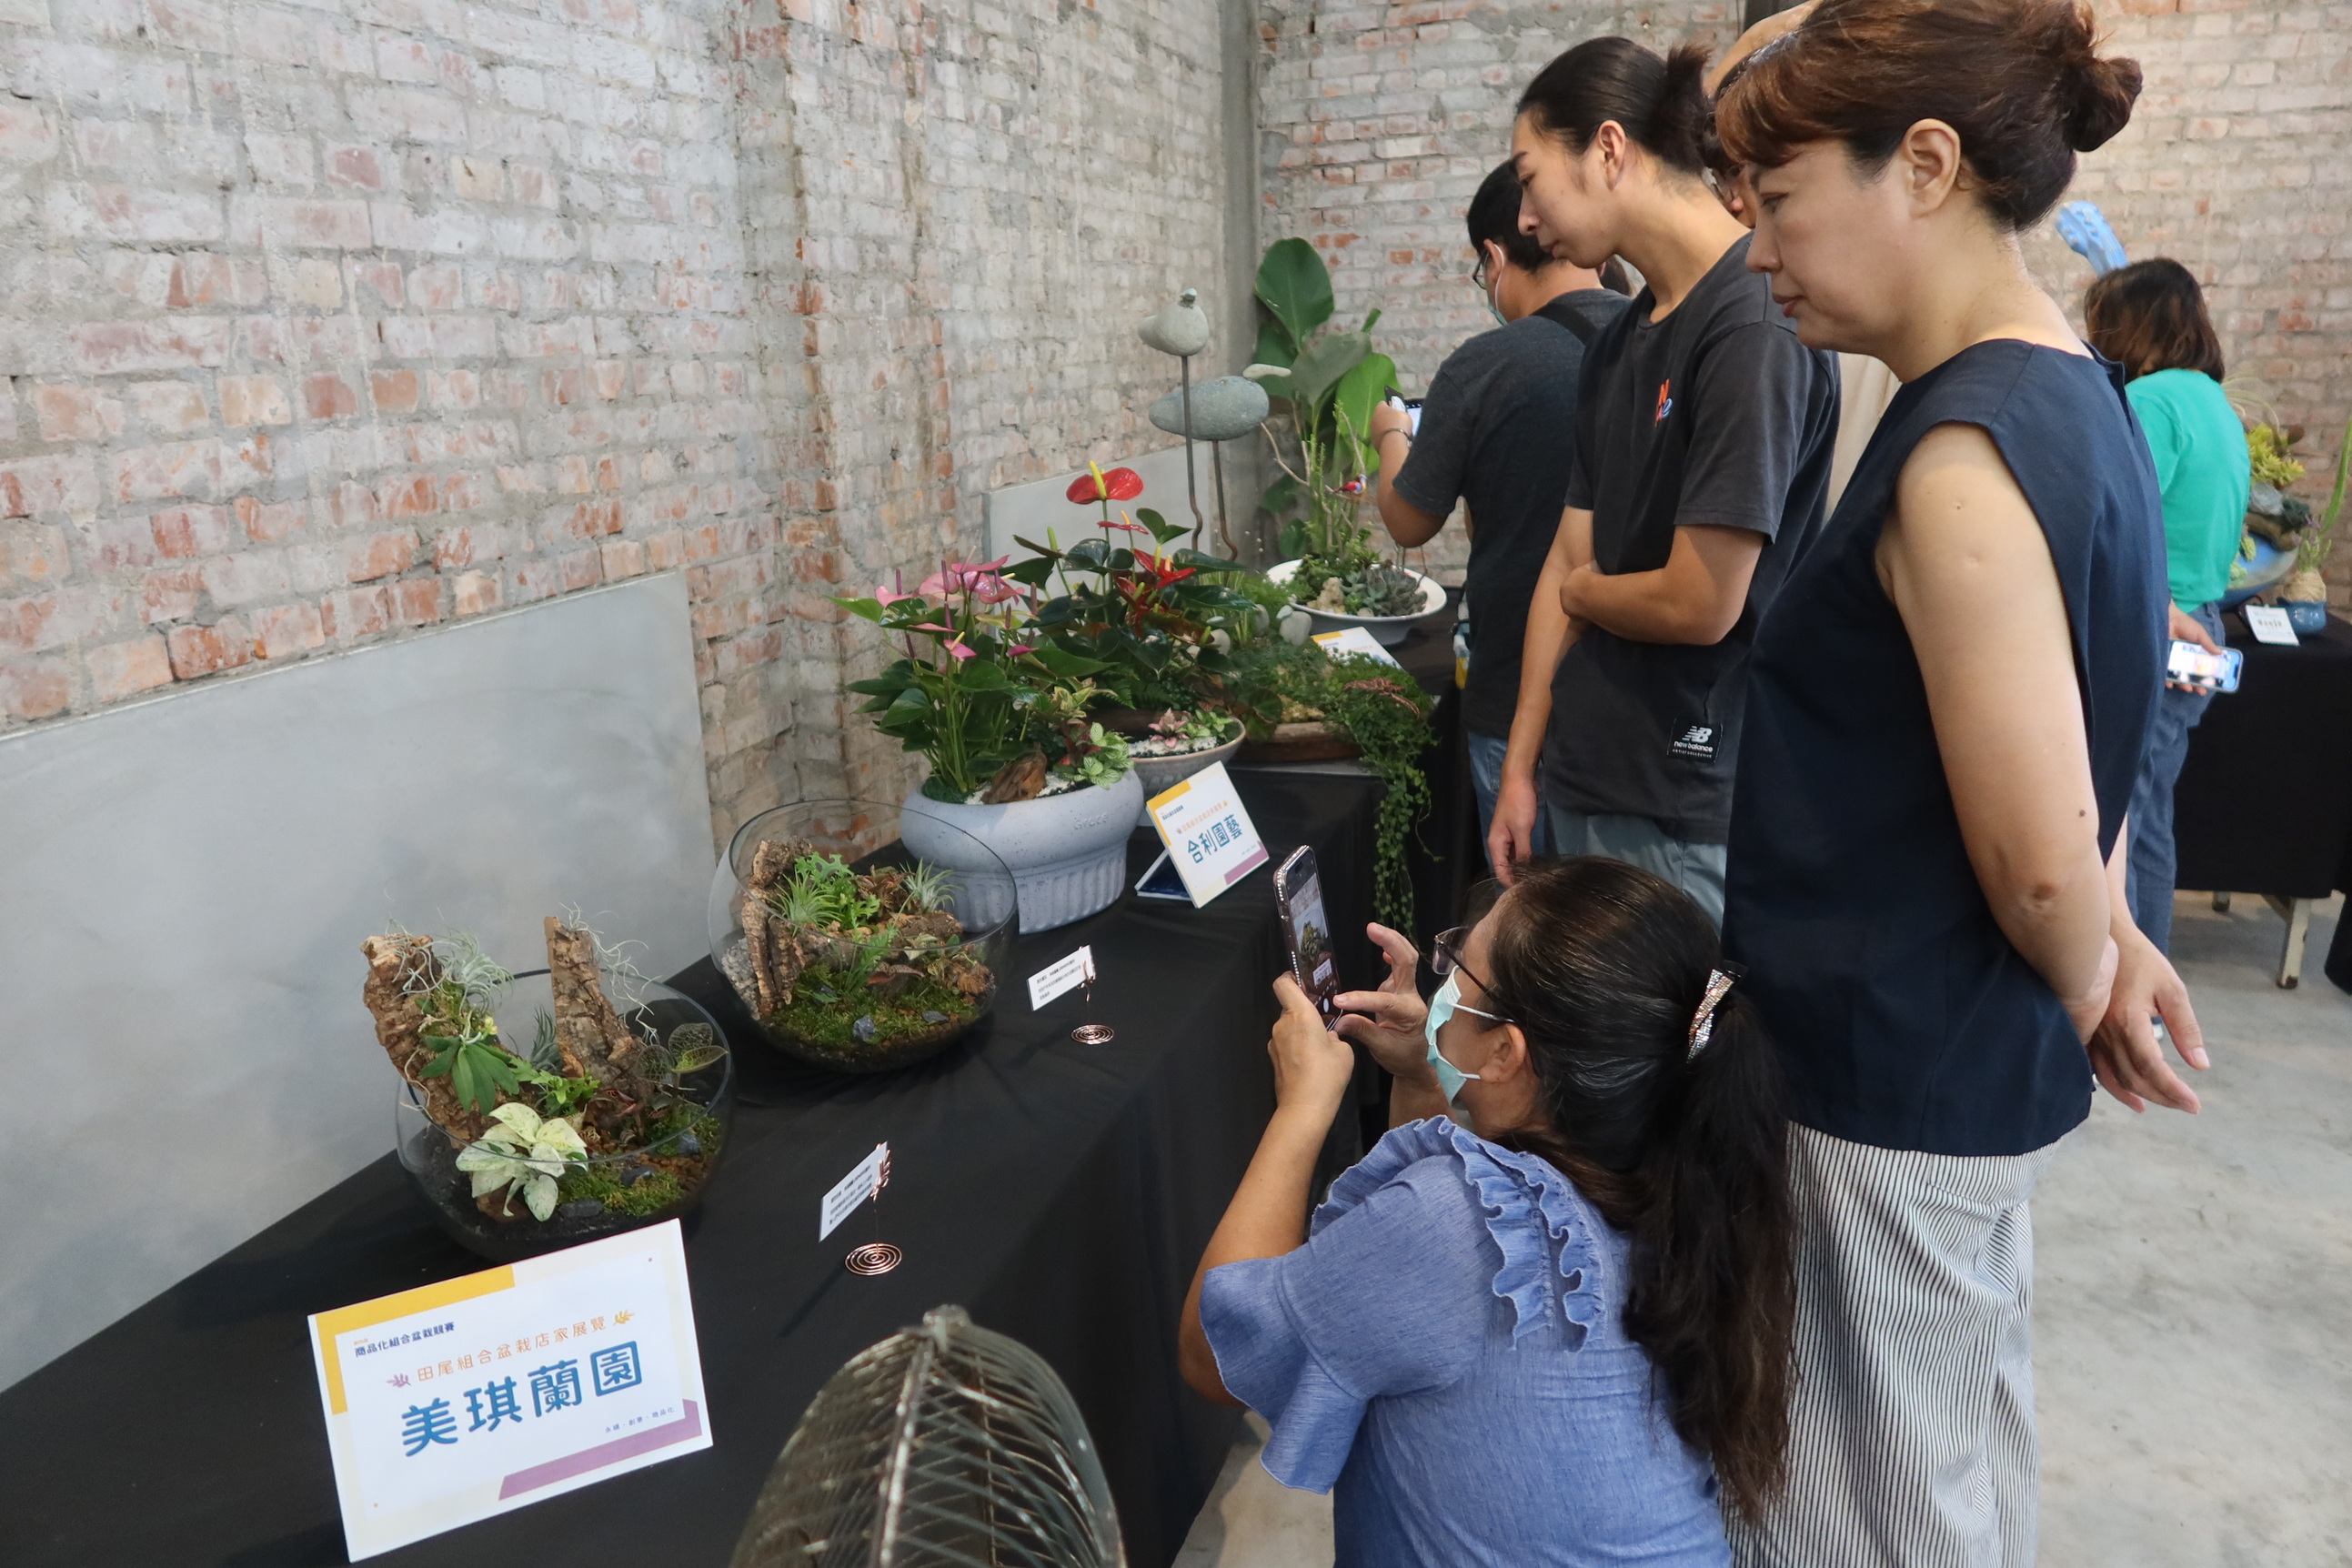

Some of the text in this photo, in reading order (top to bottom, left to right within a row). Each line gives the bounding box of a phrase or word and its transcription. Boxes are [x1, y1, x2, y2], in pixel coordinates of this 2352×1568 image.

[1688, 742, 1714, 753] balance
[1187, 814, 1242, 863] 合利園藝
[417, 1316, 607, 1382] 田尾組合盆栽店家展覽
[400, 1340, 643, 1457] 美琪蘭園
